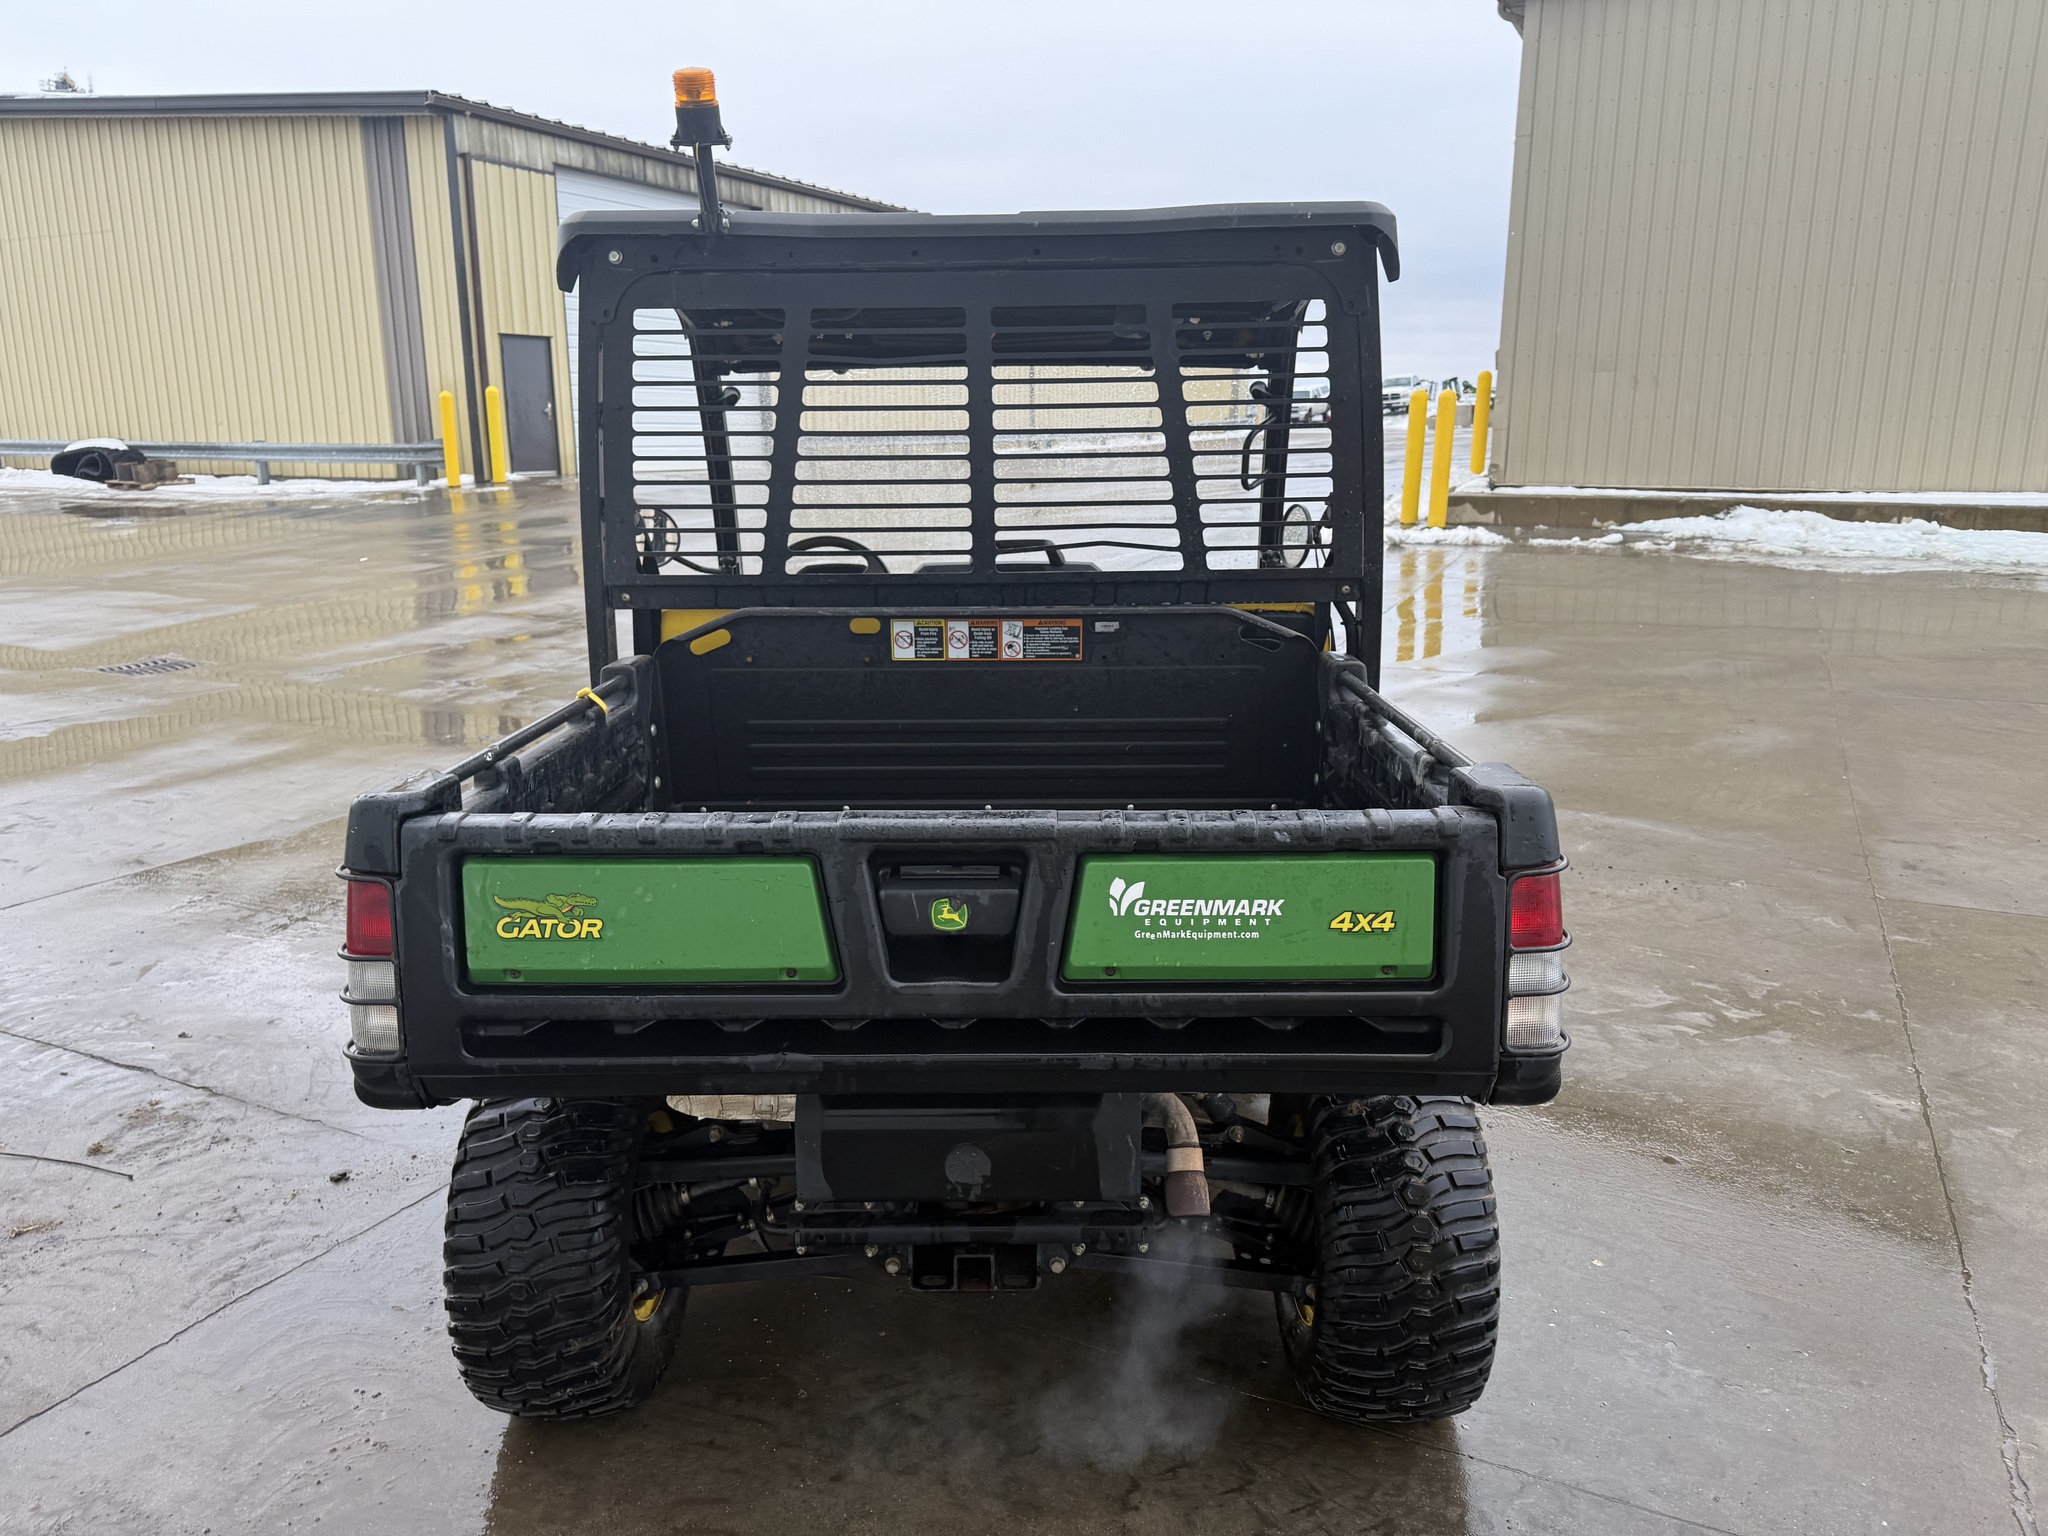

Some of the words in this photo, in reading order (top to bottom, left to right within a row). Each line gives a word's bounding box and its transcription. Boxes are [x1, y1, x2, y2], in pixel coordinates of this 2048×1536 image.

[1134, 899, 1286, 916] GREENMARK
[496, 916, 604, 939] GATOR
[1144, 918, 1272, 926] EQUIPMENT
[1329, 911, 1396, 932] 4x4
[1134, 930, 1260, 941] GreenMarkEquipment.com
